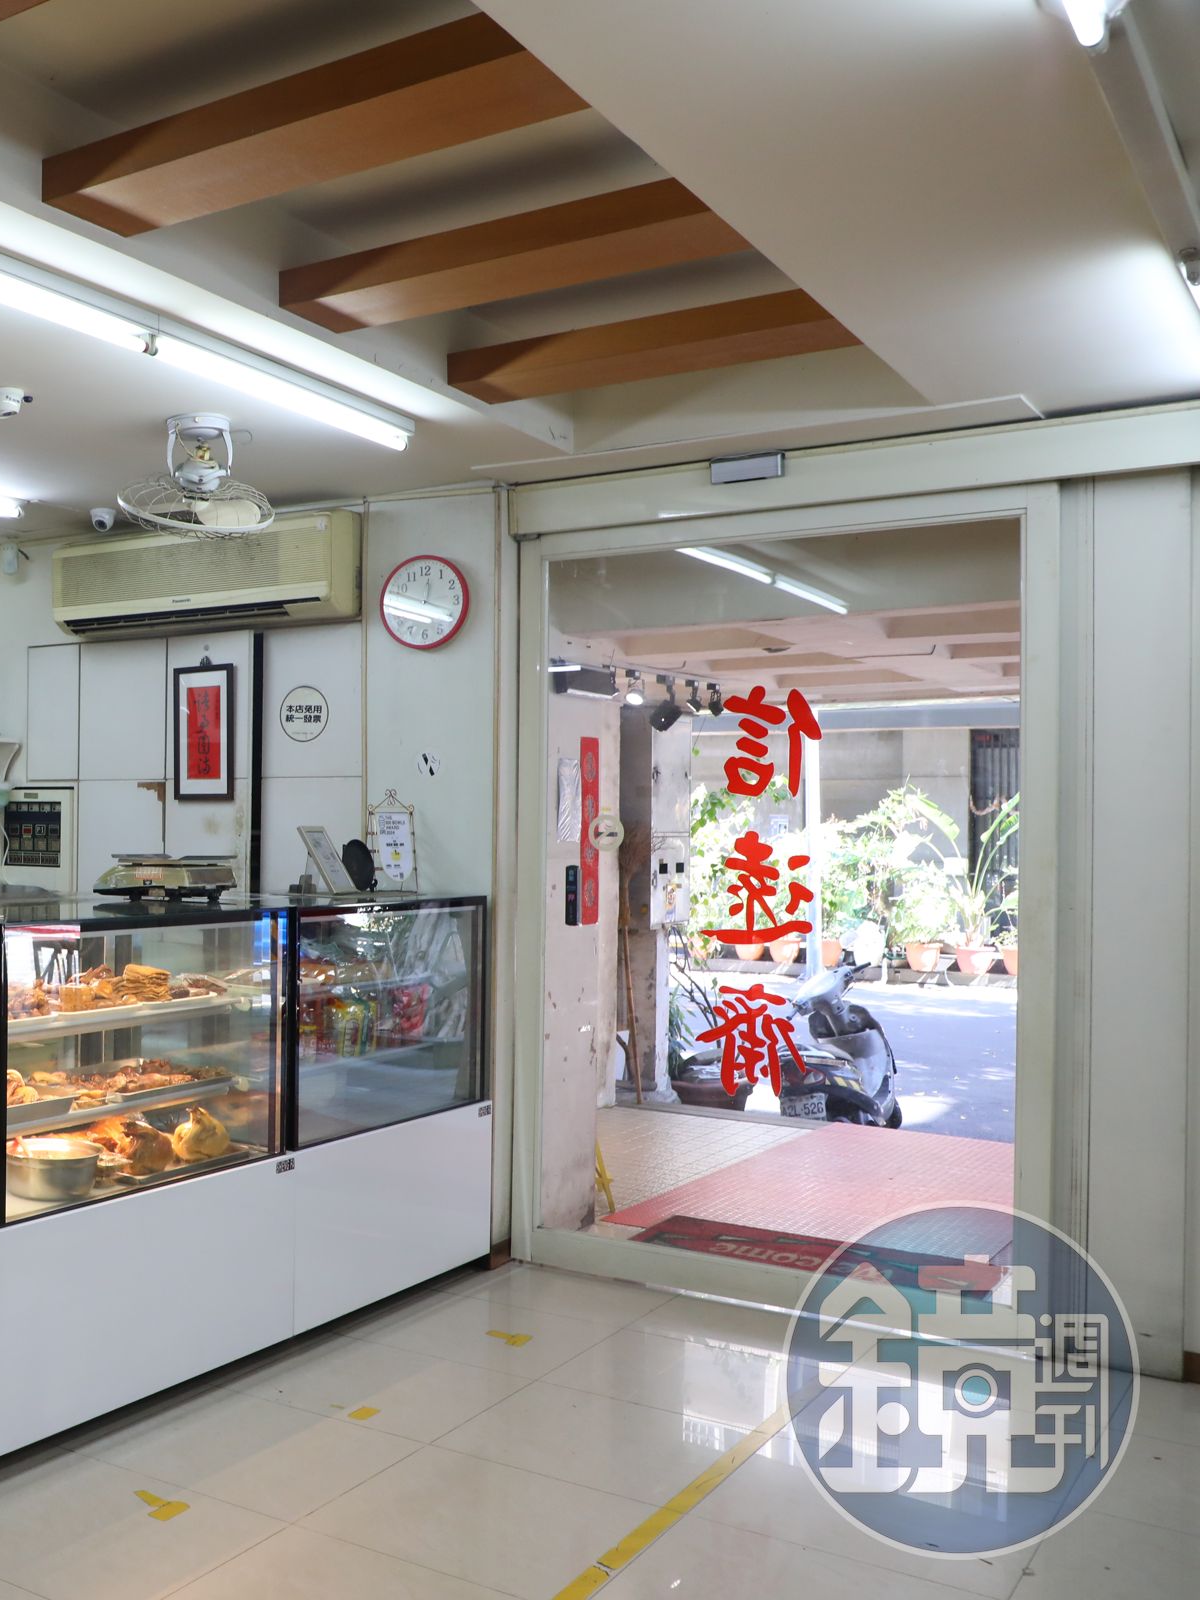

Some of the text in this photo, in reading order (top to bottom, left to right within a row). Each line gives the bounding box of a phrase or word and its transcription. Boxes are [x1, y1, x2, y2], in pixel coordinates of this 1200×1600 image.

[419, 565, 431, 577] 12
[439, 569, 443, 580] 1
[407, 572, 416, 582] 11
[448, 579, 456, 590] 2
[453, 594, 460, 606] 3
[421, 629, 429, 640] 6
[285, 714, 321, 723] 統一發票
